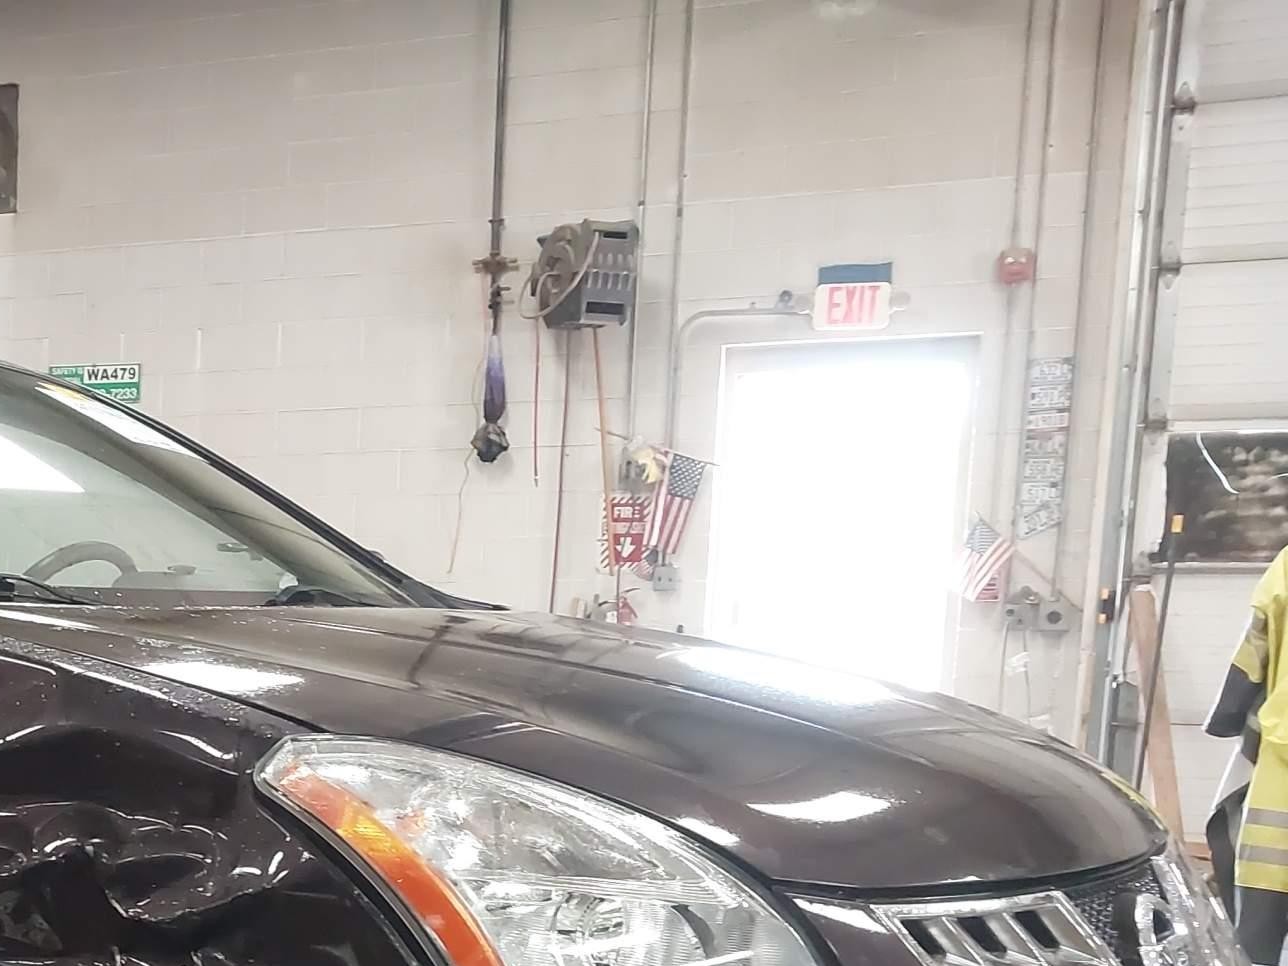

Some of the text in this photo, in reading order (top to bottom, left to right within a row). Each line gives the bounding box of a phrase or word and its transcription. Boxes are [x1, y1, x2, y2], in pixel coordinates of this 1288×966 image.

[826, 286, 881, 324] EXIT
[87, 367, 137, 381] WA479
[613, 506, 641, 518] FIRE
